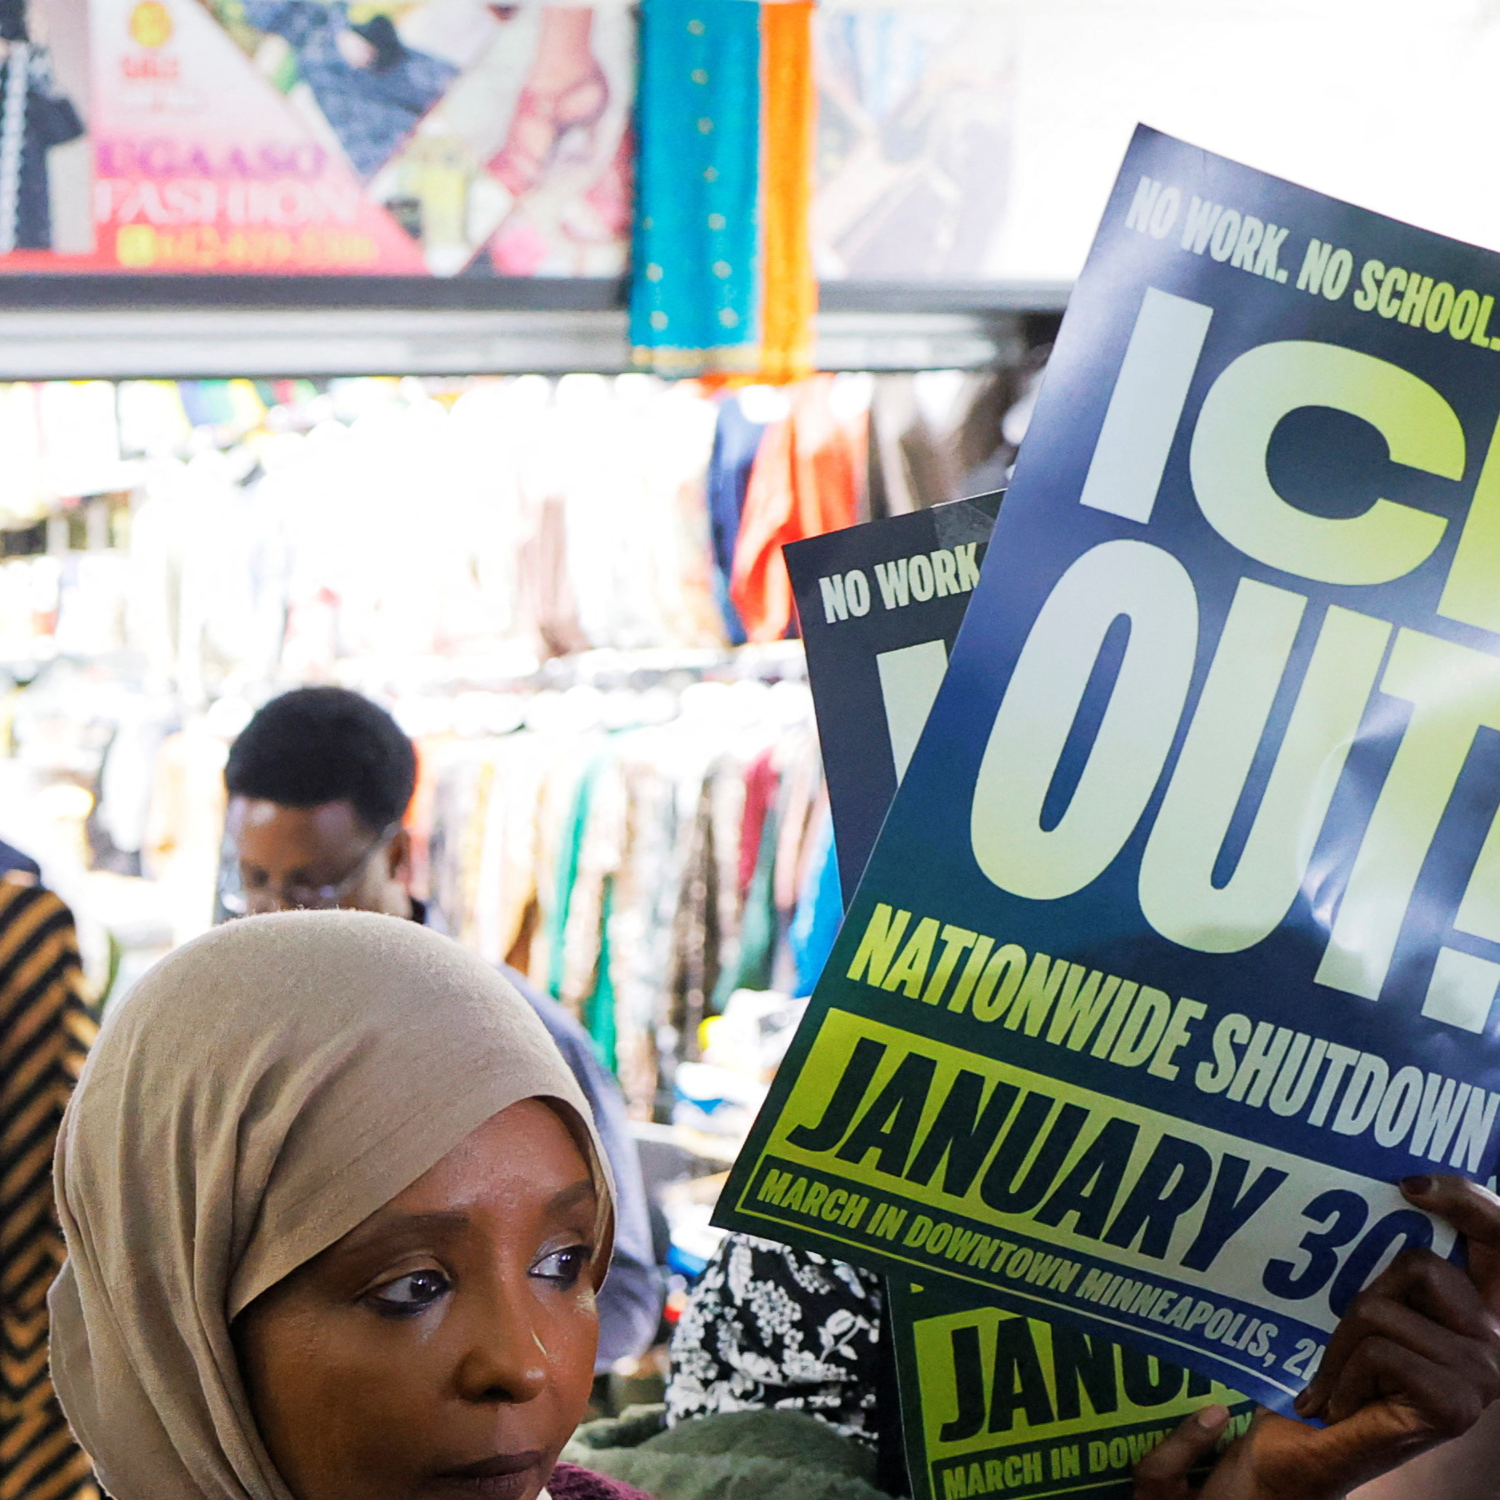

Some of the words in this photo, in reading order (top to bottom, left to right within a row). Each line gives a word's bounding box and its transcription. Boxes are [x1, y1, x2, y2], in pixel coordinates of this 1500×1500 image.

[1125, 176, 1175, 240] NO
[1180, 196, 1289, 284] WORK.
[1297, 239, 1352, 301] NO
[1353, 259, 1500, 351] SCHOOL.
[819, 569, 871, 624] NO
[846, 903, 1206, 1080] NATIONWIDE
[1196, 1013, 1500, 1174] SHUTDOWN
[786, 1033, 1289, 1273] JANUARY
[757, 1168, 866, 1236] MARCH
[867, 1203, 909, 1243] IN
[906, 1212, 1082, 1293] DOWNTOWN
[1077, 1267, 1279, 1368] MINNEAPOLIS,
[938, 1316, 1214, 1443] JANU
[1051, 1444, 1080, 1481] IN
